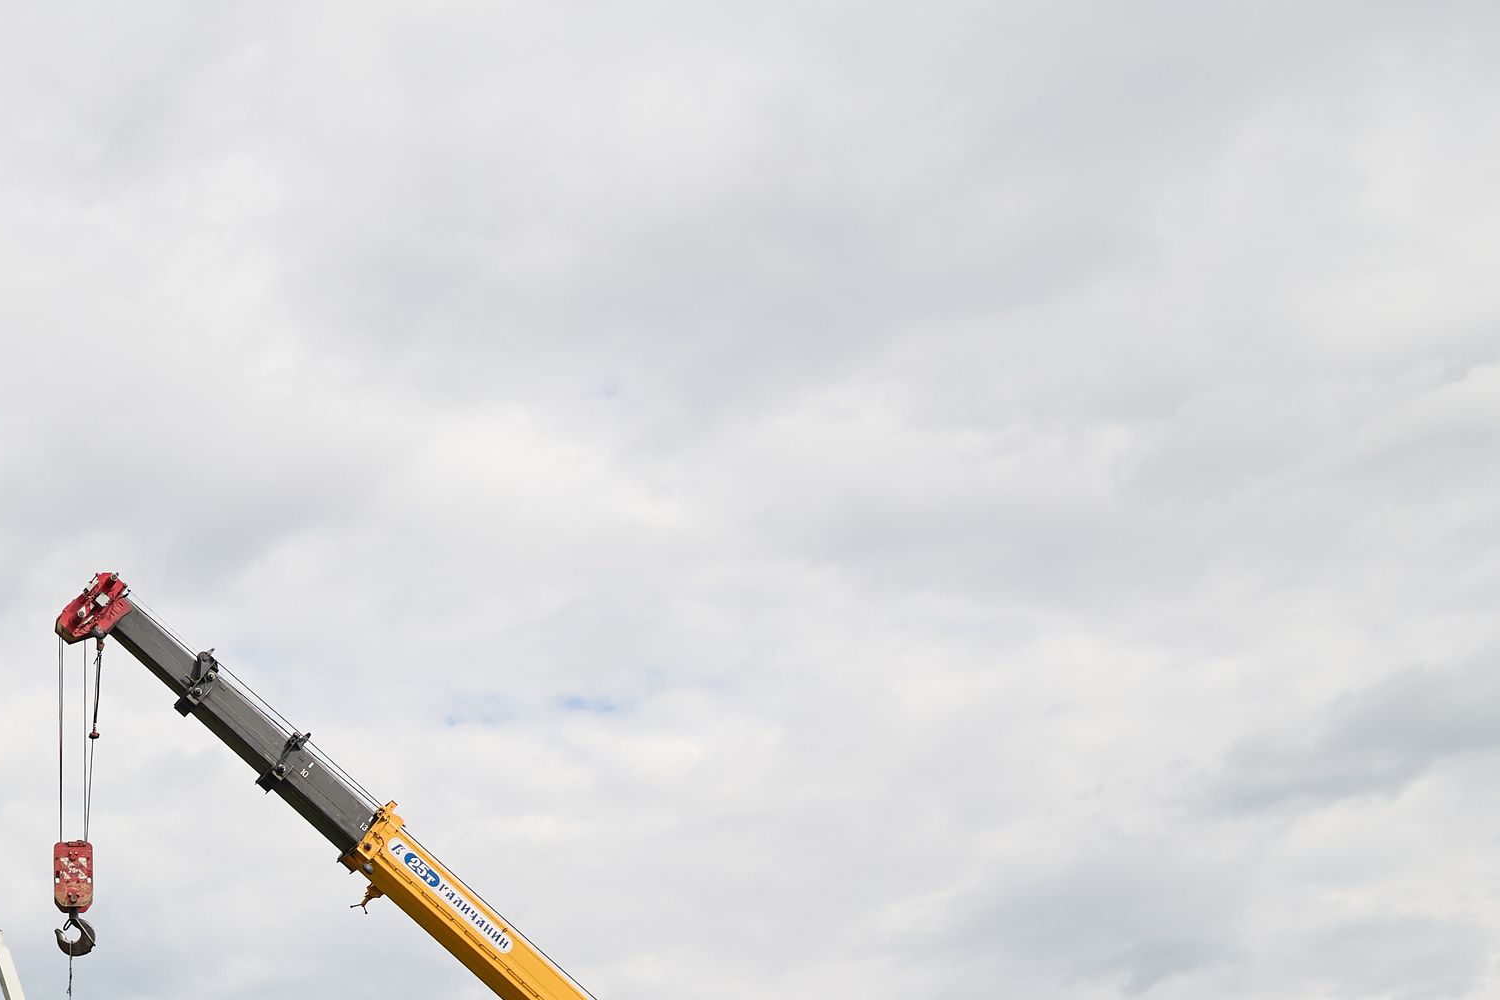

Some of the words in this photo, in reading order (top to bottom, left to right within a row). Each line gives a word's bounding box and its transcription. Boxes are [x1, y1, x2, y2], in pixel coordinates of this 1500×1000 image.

[300, 768, 309, 778] 10
[359, 822, 369, 832] 13
[438, 883, 510, 950] ГАЛИЧАНИН
